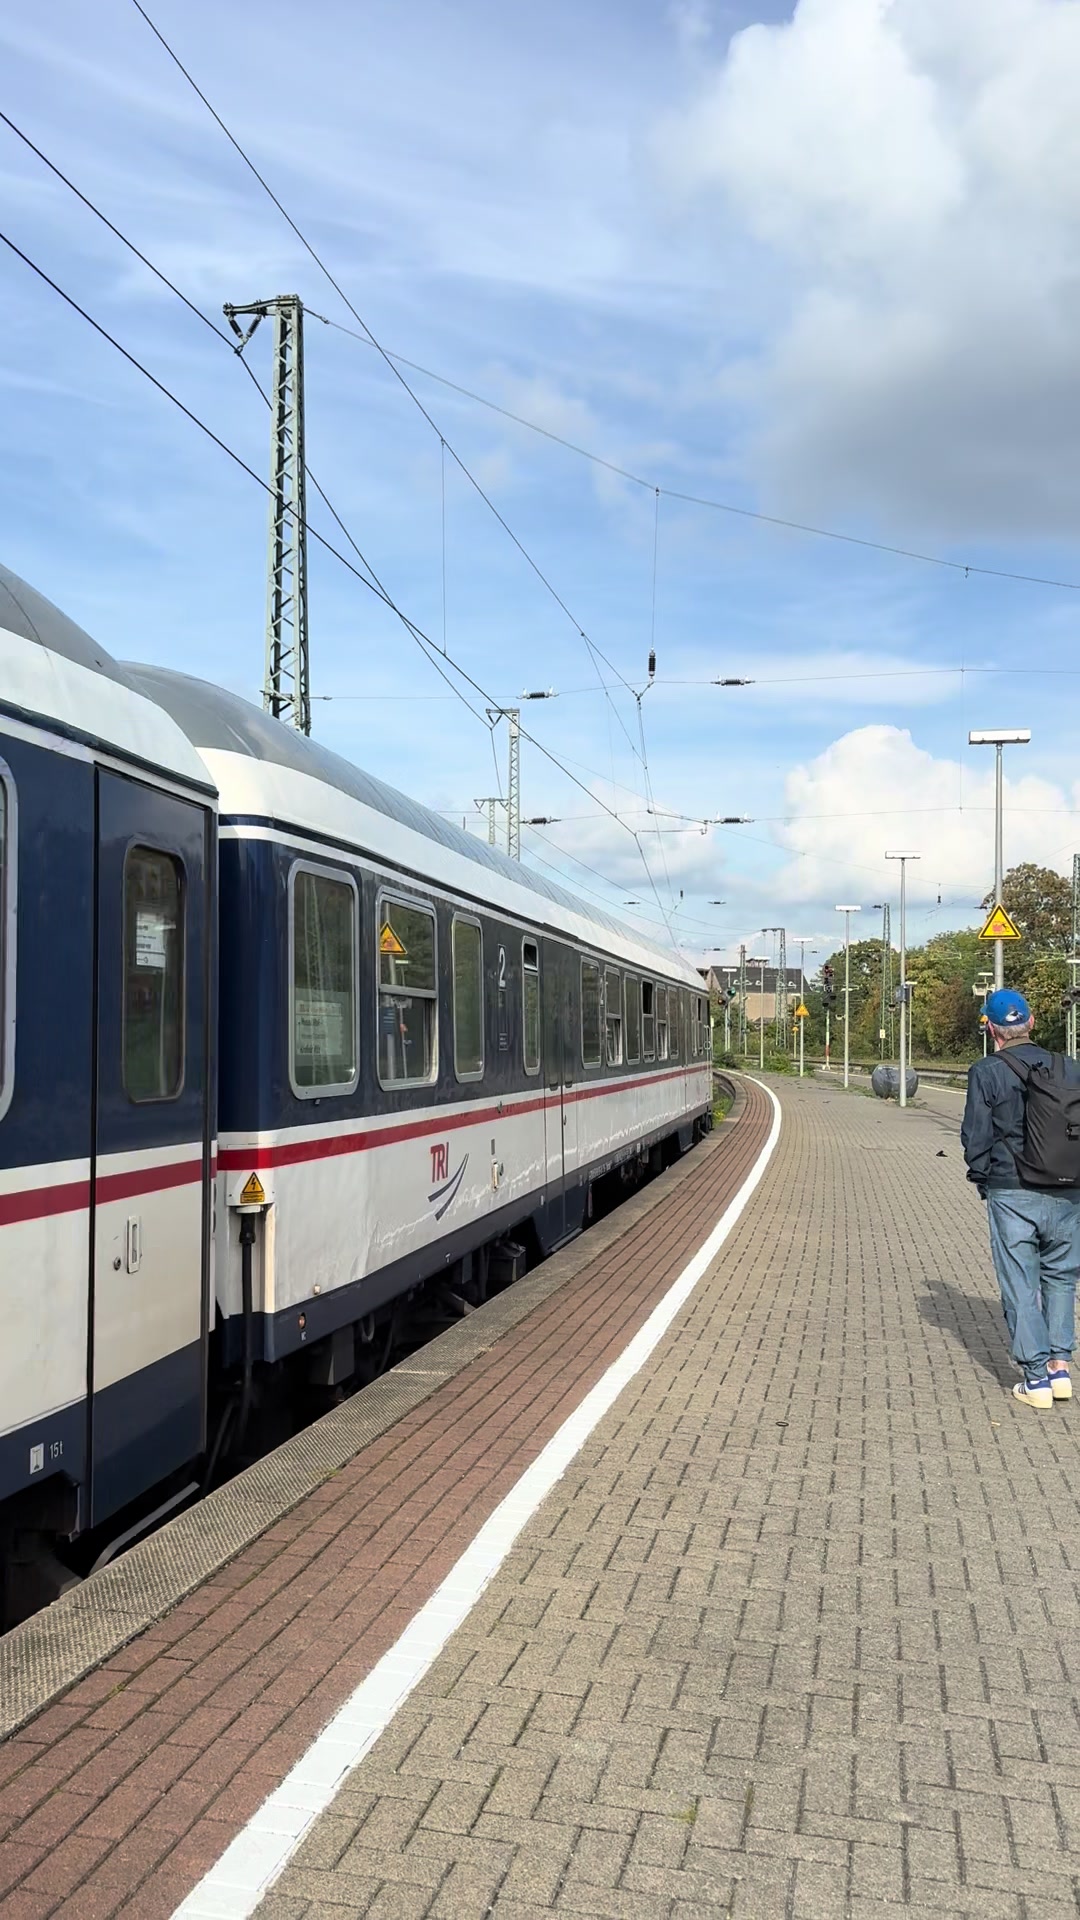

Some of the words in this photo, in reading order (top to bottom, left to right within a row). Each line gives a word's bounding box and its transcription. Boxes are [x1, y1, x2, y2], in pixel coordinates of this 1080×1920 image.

[499, 947, 506, 988] 2
[430, 1141, 449, 1183] TRI
[49, 1440, 63, 1460] 15t
